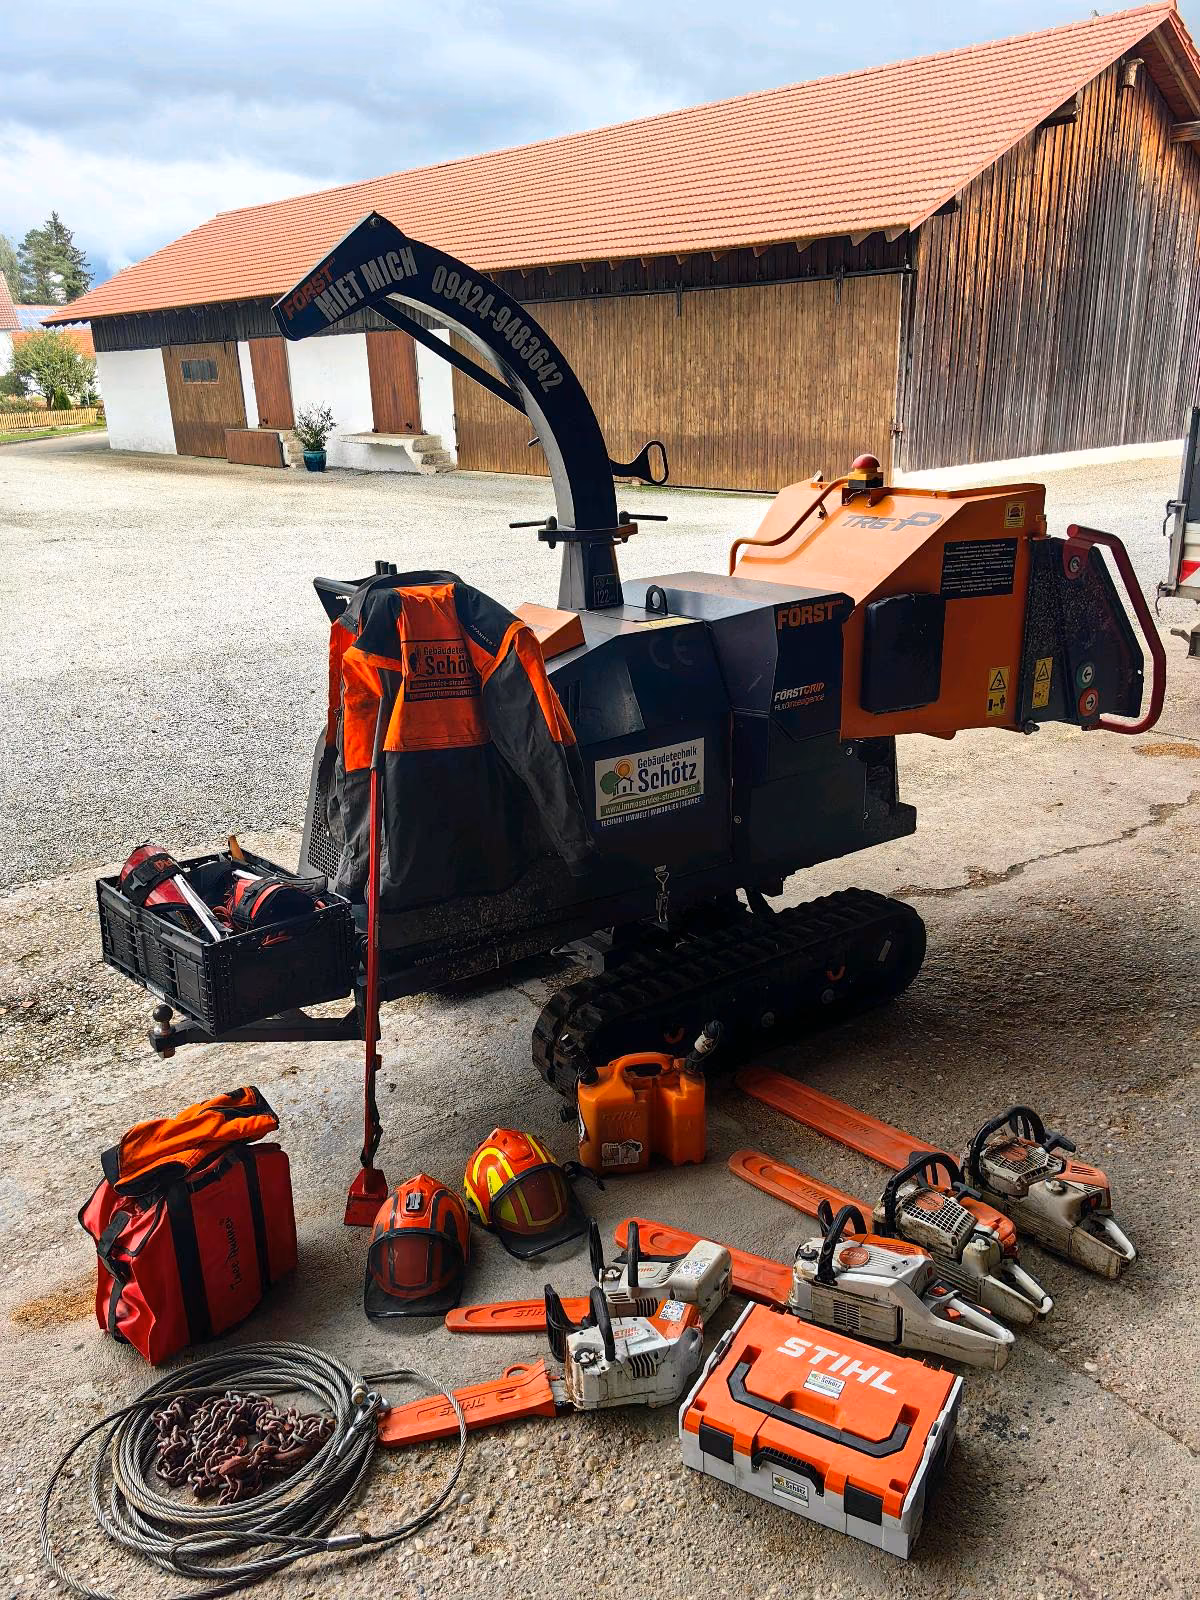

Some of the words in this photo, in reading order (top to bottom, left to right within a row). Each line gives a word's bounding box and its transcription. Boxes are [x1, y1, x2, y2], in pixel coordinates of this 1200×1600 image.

[314, 272, 364, 323] MIET
[360, 247, 419, 292] MICH
[431, 265, 564, 393] 09424-9483642
[637, 745, 697, 769] Gebäudetechnik
[638, 761, 697, 793] Schötz
[513, 1308, 546, 1318] STIH
[777, 1336, 897, 1395] STIHL
